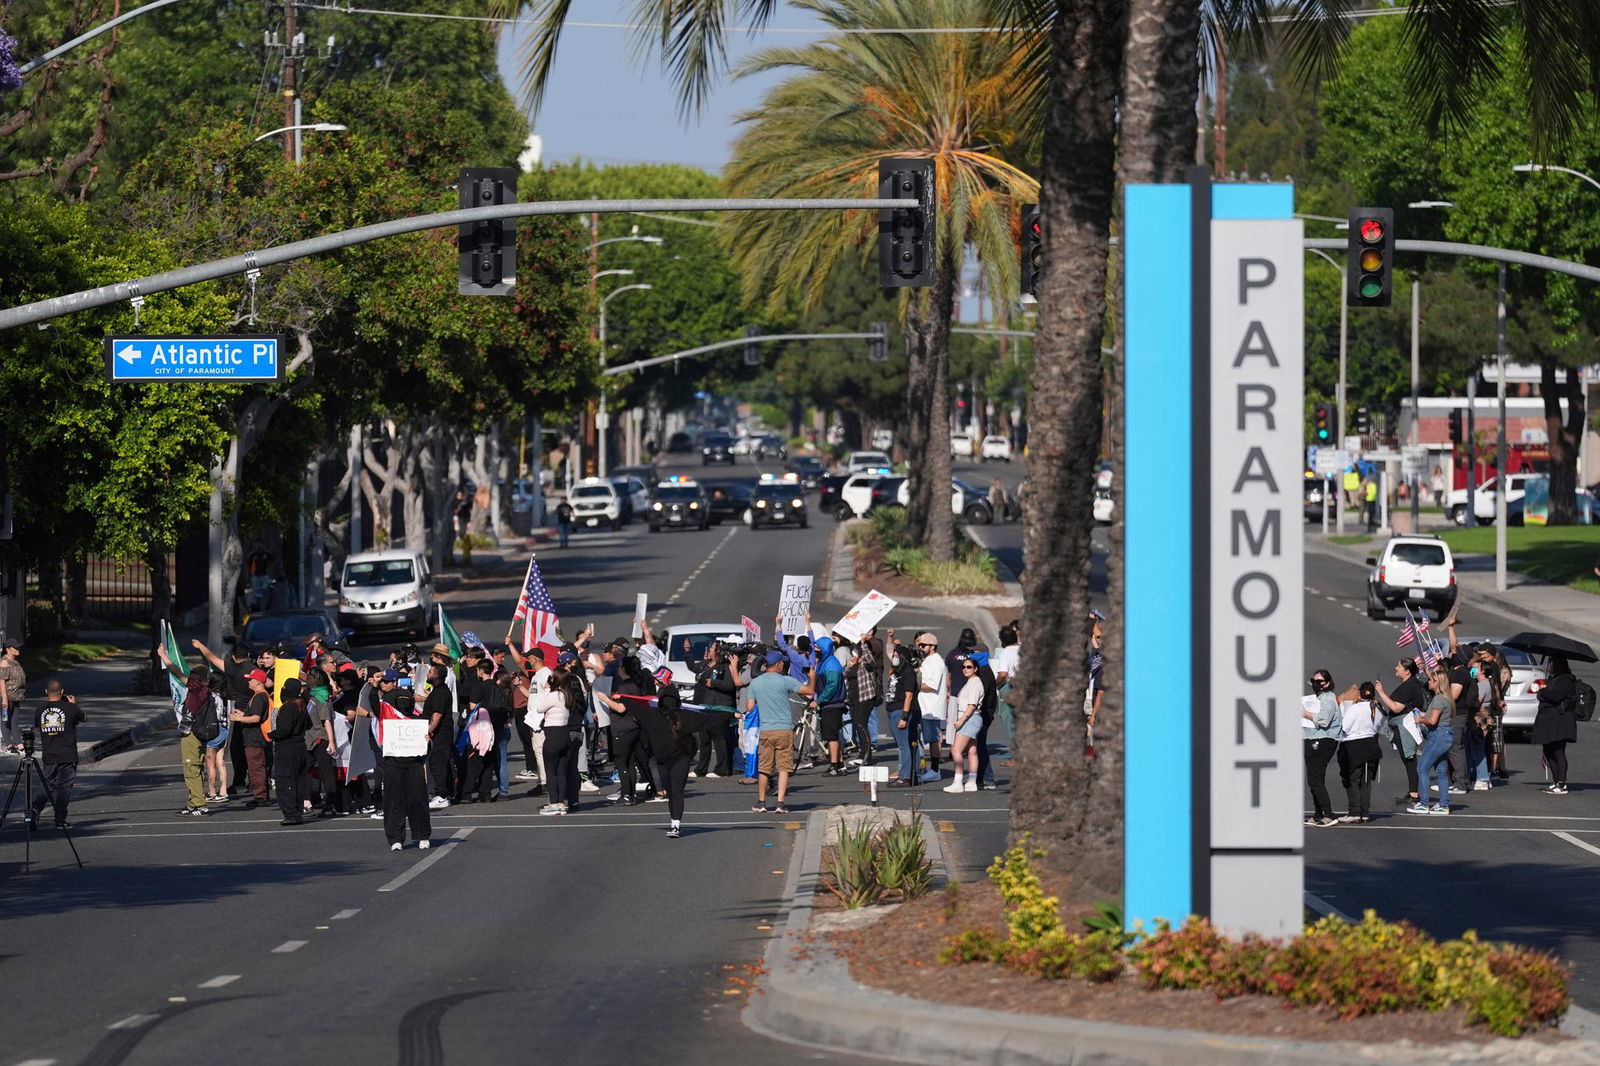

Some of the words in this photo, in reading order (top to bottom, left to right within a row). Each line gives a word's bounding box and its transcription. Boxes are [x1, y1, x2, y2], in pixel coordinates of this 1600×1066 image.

[150, 343, 243, 365] Atlantic
[253, 343, 274, 365] Pl
[1230, 257, 1282, 808] PARAMOUNT
[786, 584, 812, 599] FUCK
[395, 725, 419, 737] ICE
